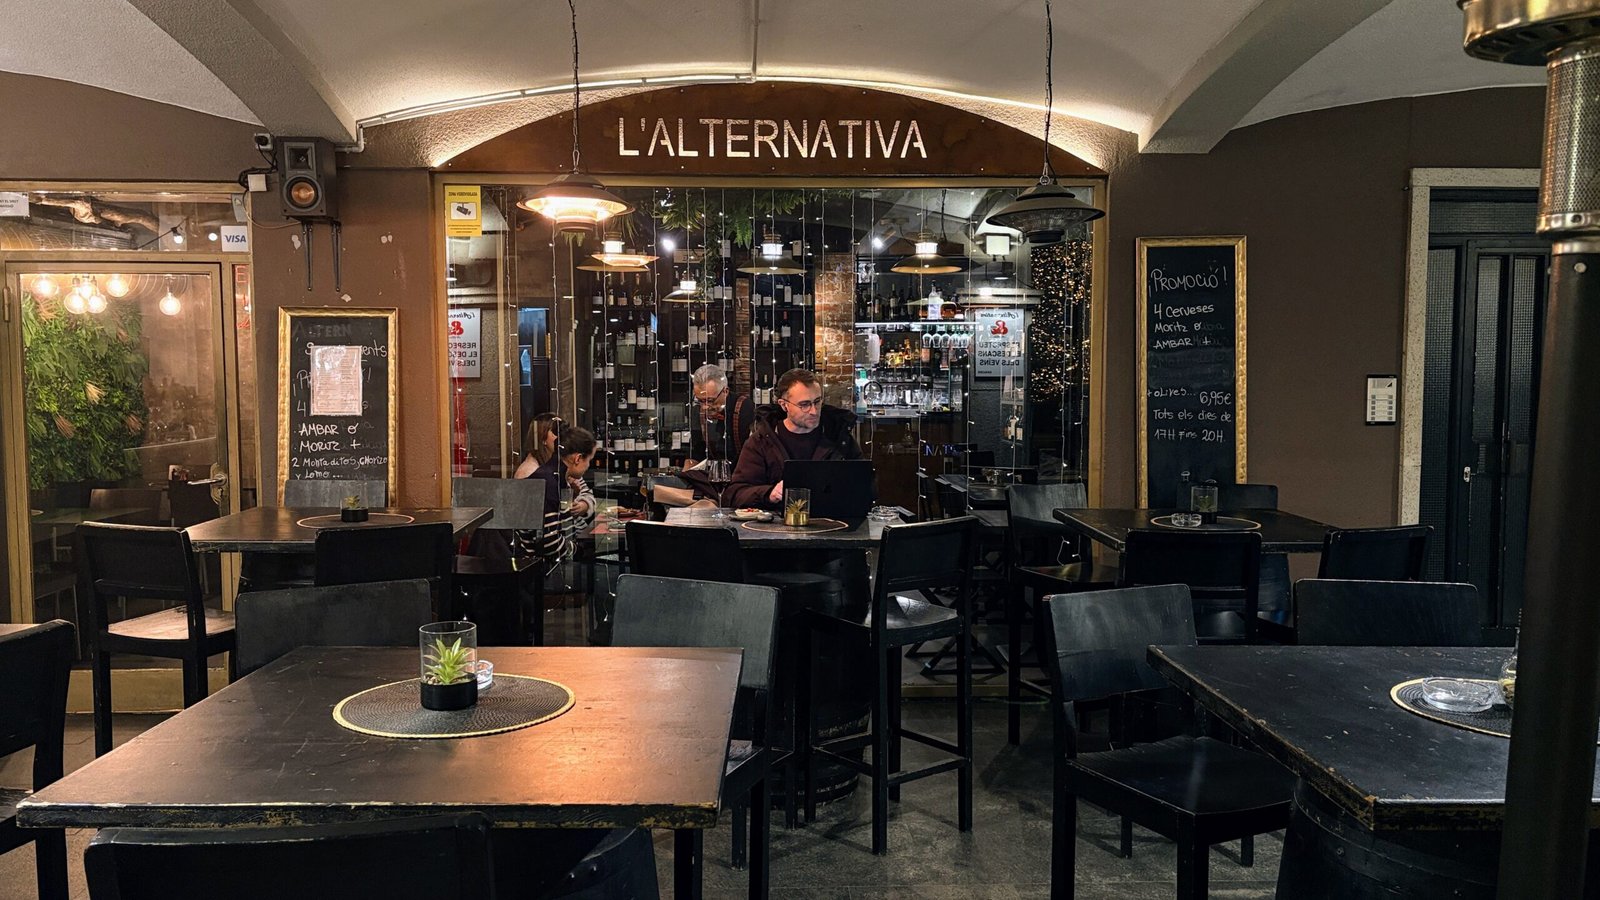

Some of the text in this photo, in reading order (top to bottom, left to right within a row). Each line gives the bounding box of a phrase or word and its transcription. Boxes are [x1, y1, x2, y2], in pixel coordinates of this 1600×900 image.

[618, 117, 927, 158] L'ALTERNATIVA
[225, 234, 246, 243] VISA
[1154, 303, 1214, 320] 4 Cerveses
[1154, 321, 1188, 333] Moritz
[1153, 337, 1193, 350] AMBAR
[1200, 390, 1232, 406] 6,95€
[1153, 408, 1232, 422] Tots els dies de
[299, 422, 339, 437] AMBAR
[1154, 428, 1175, 440] 17H
[291, 457, 300, 468] 2
